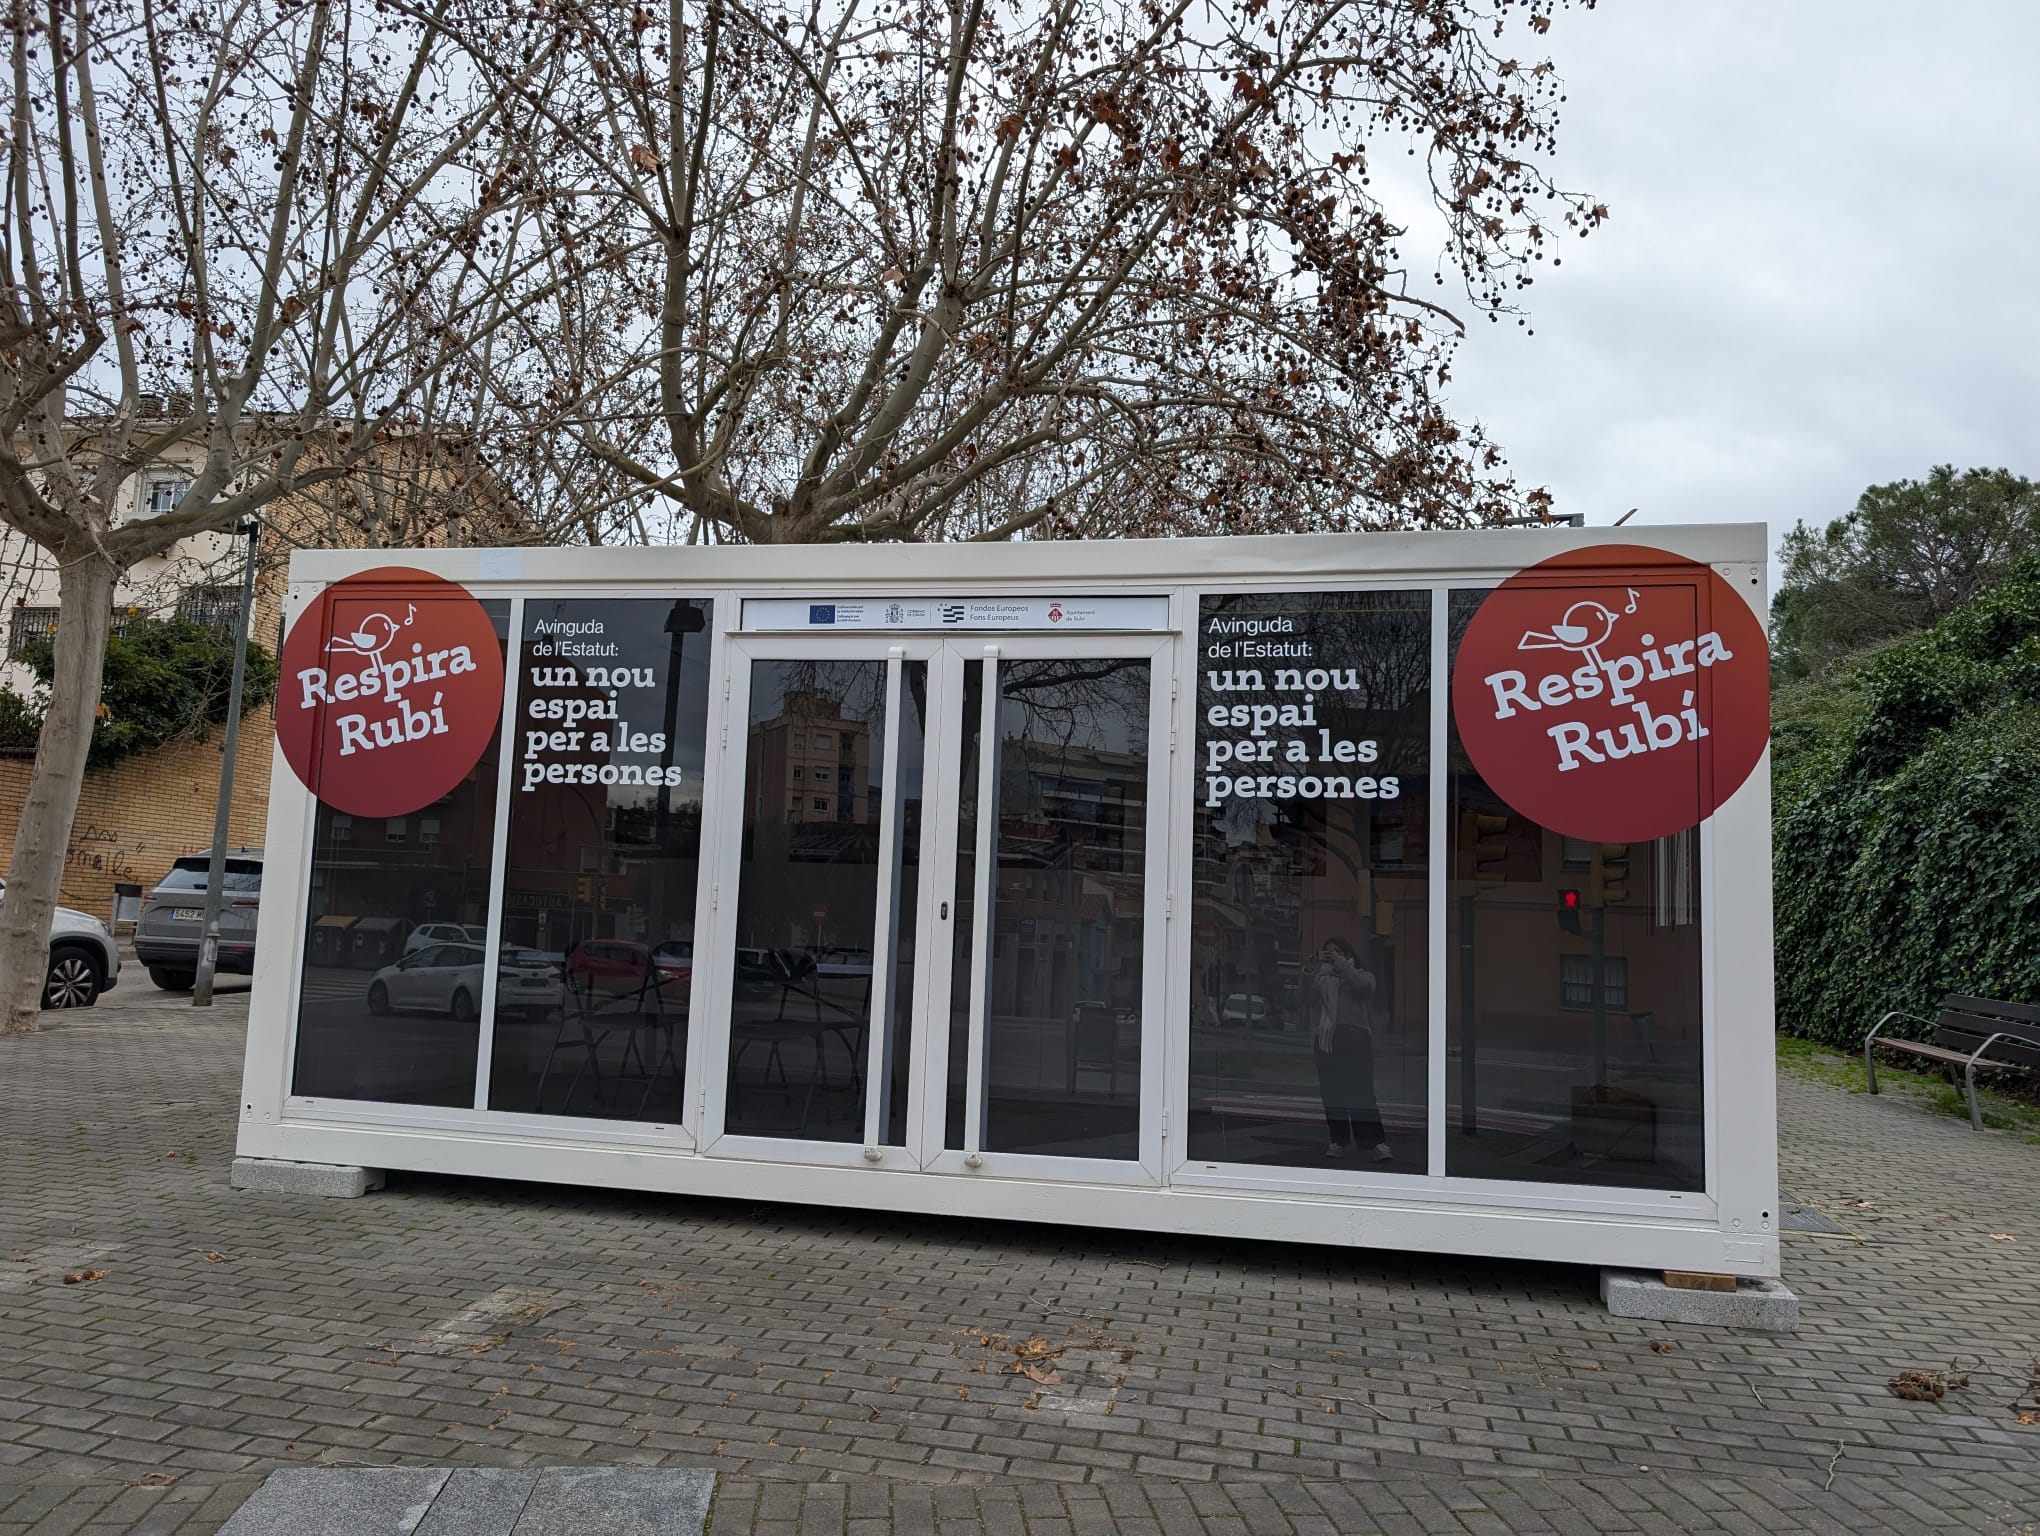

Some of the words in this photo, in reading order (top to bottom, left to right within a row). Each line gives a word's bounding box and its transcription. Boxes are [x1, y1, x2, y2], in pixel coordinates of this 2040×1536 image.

[534, 618, 605, 637] Avinguda
[1208, 617, 1293, 636] Avinguda
[533, 641, 553, 657] de
[555, 641, 619, 657] l'Estatut:
[1208, 641, 1232, 658] de
[1235, 641, 1312, 658] l'Estatut:
[297, 642, 478, 709] Respira
[531, 667, 579, 688] un
[585, 667, 656, 688] nou
[1207, 668, 1266, 692] un
[1274, 668, 1360, 692] nou
[1484, 631, 1734, 720] Respira
[336, 691, 450, 757] Rubí
[529, 689, 619, 728] espai
[1207, 693, 1317, 736] espai
[524, 731, 585, 760] per
[590, 731, 610, 752] a
[617, 721, 666, 753] les
[1546, 689, 1710, 773] Rubí
[1206, 740, 1278, 772] per
[1285, 740, 1310, 763] a
[1318, 728, 1378, 763] les
[521, 763, 682, 792] persones
[1205, 775, 1401, 807] persones
